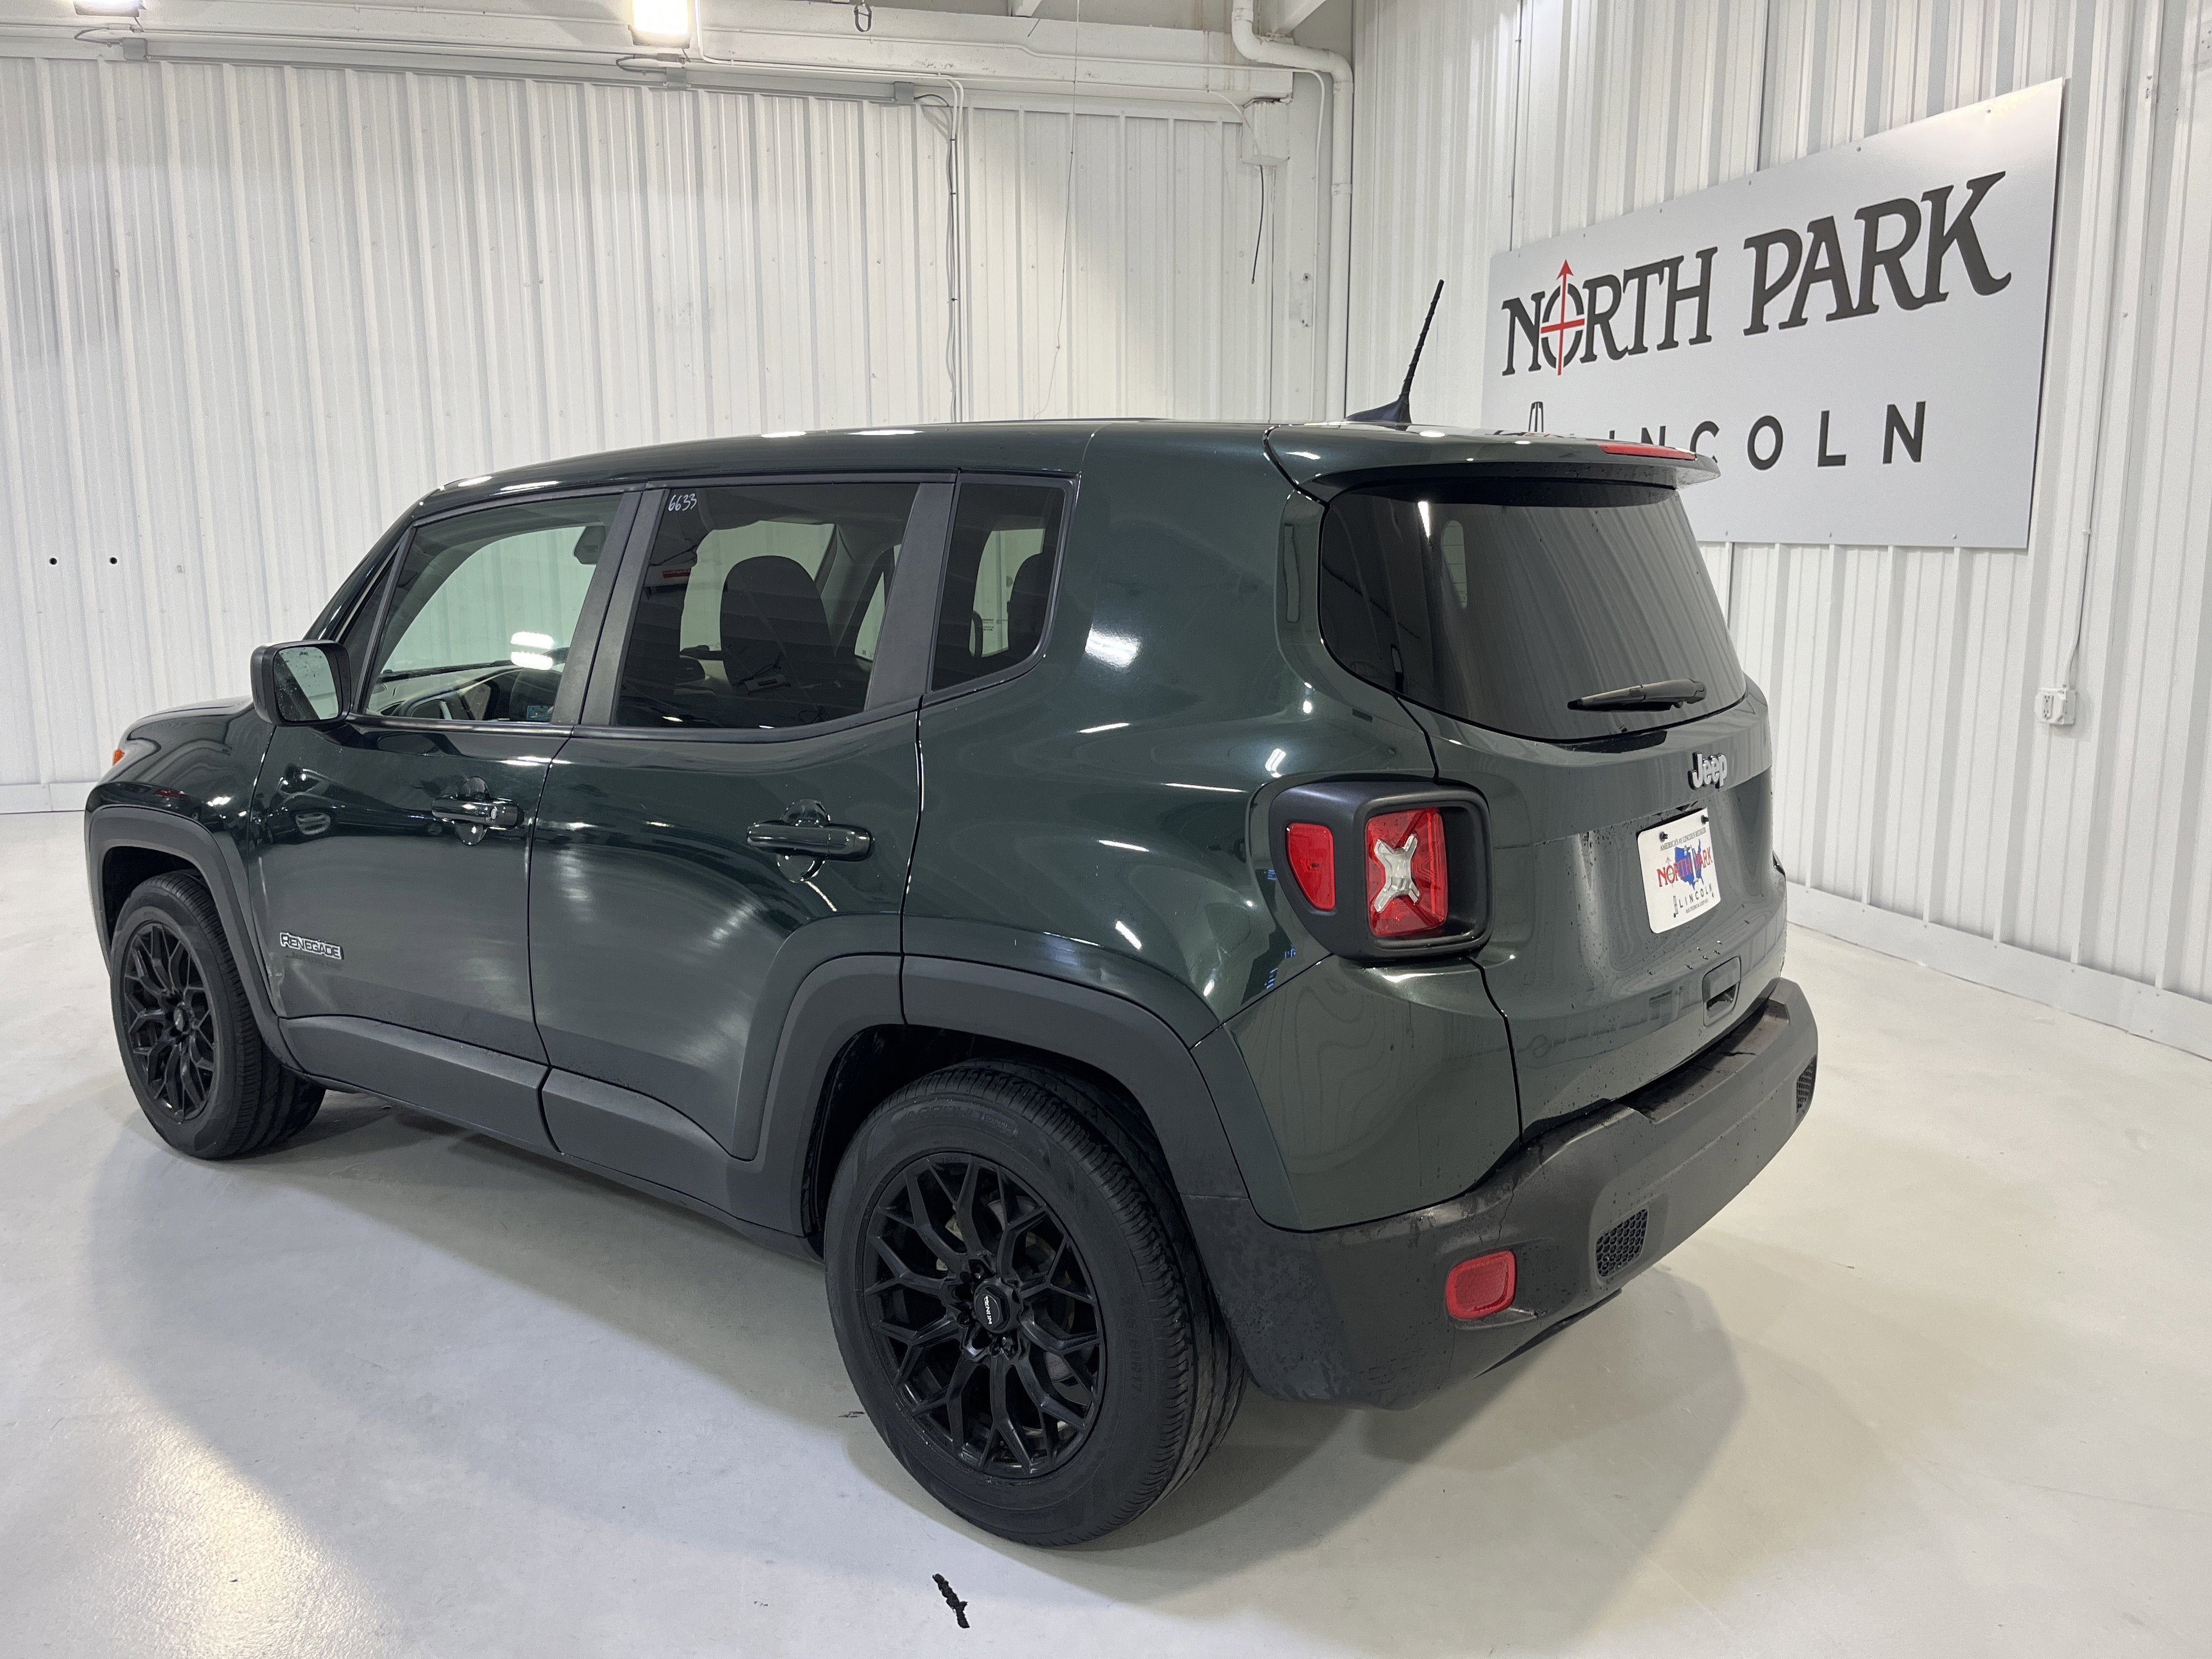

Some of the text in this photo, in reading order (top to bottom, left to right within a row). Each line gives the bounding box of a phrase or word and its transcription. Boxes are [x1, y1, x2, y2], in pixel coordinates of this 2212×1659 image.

[1502, 171, 2012, 376] NORTH PARK
[1609, 401, 1926, 471] COLN
[668, 493, 697, 511] 6633
[1688, 751, 1728, 789] Jeep
[1657, 856, 1694, 888] NORTH
[1679, 883, 1712, 909] LINCOLN
[279, 932, 343, 961] RENEGADE
